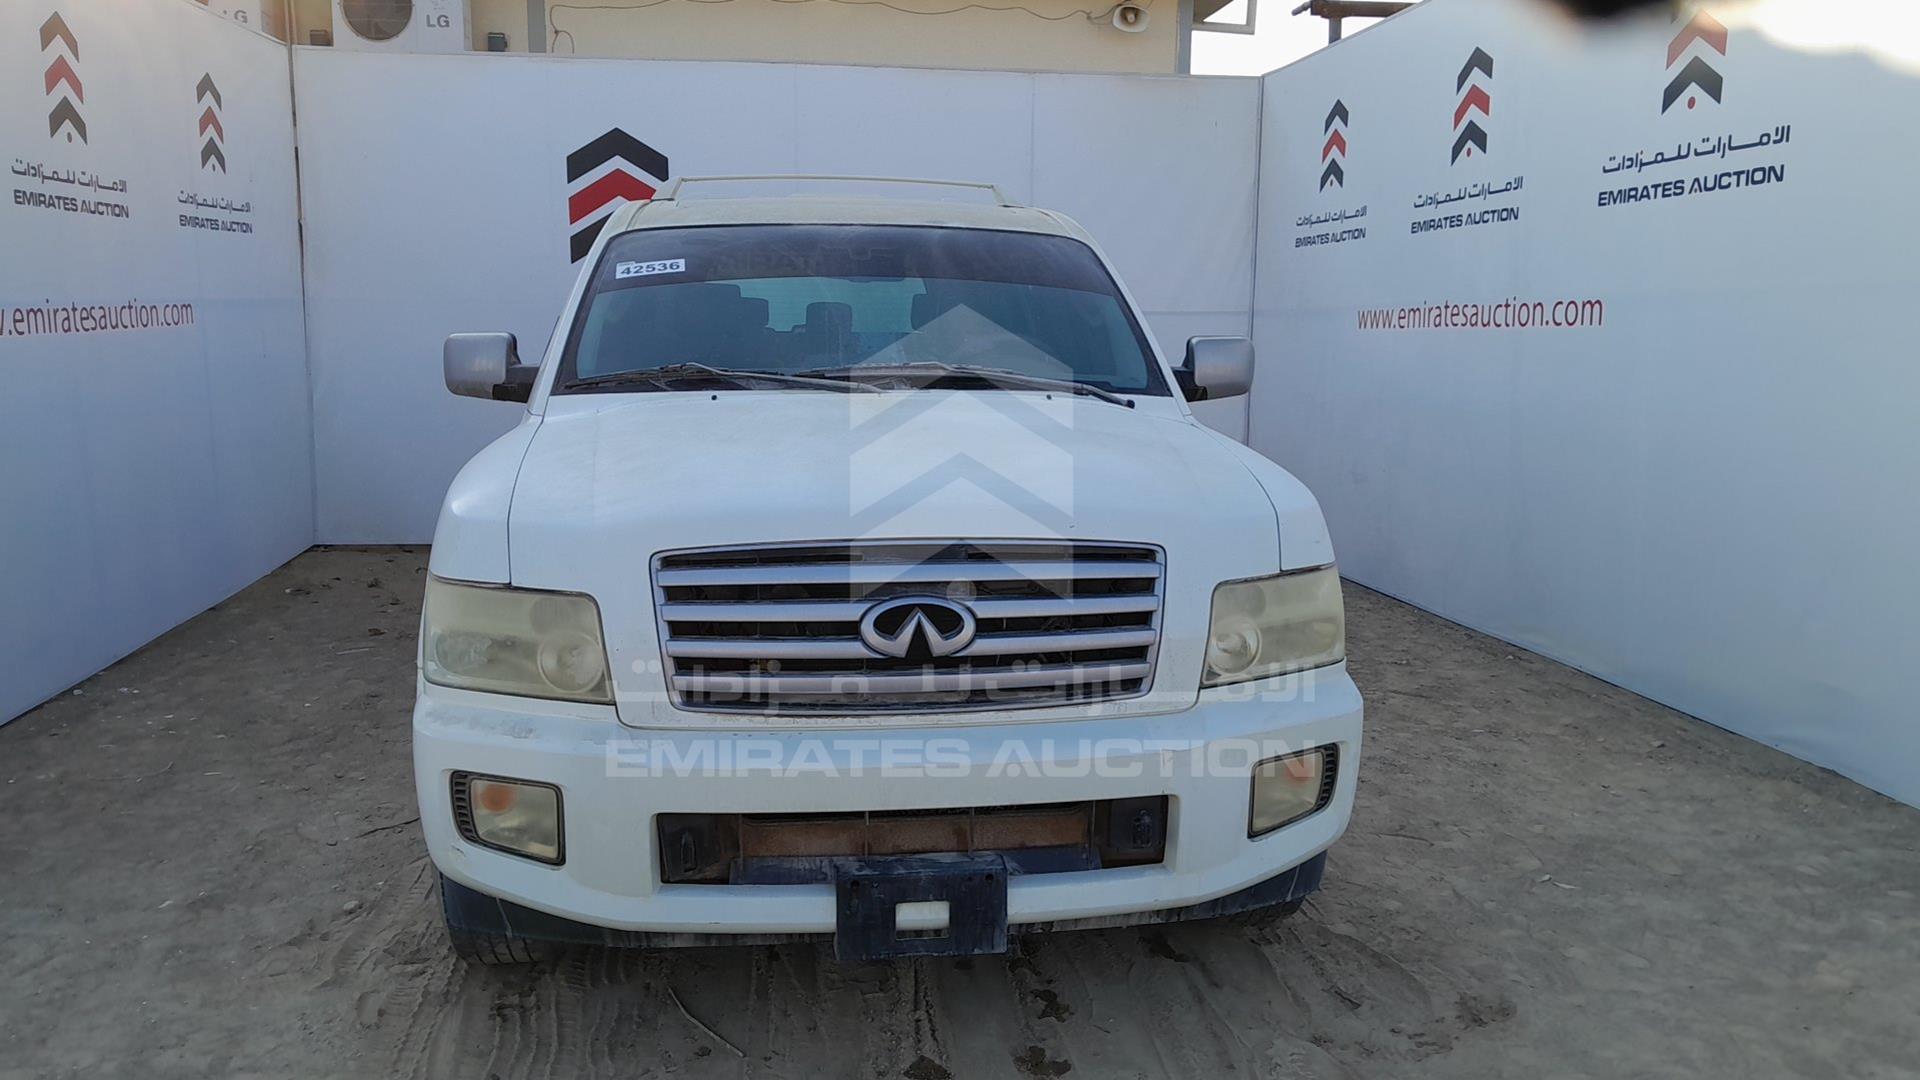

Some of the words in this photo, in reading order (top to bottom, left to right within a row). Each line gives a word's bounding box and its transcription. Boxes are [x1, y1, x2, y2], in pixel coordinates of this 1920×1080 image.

[222, 9, 248, 24] G
[426, 14, 450, 28] LG
[1602, 142, 1691, 173] للمزادات
[1598, 179, 1685, 207] EMIRATES
[1688, 164, 1785, 195] AUCTION
[13, 189, 78, 212] EMIRATES
[80, 200, 129, 218] AUCTION
[179, 214, 220, 231] EMIRATES
[221, 220, 253, 234] AUCTION
[1411, 213, 1463, 234] EMIRATES
[1464, 207, 1520, 226] AUCTION
[1295, 233, 1330, 248] EMIRATES
[1331, 227, 1366, 243] AUCTION
[620, 261, 680, 275] 42536
[0, 298, 194, 336] .emiratesauction.com
[1357, 296, 1603, 329] www.emiratesauction.com
